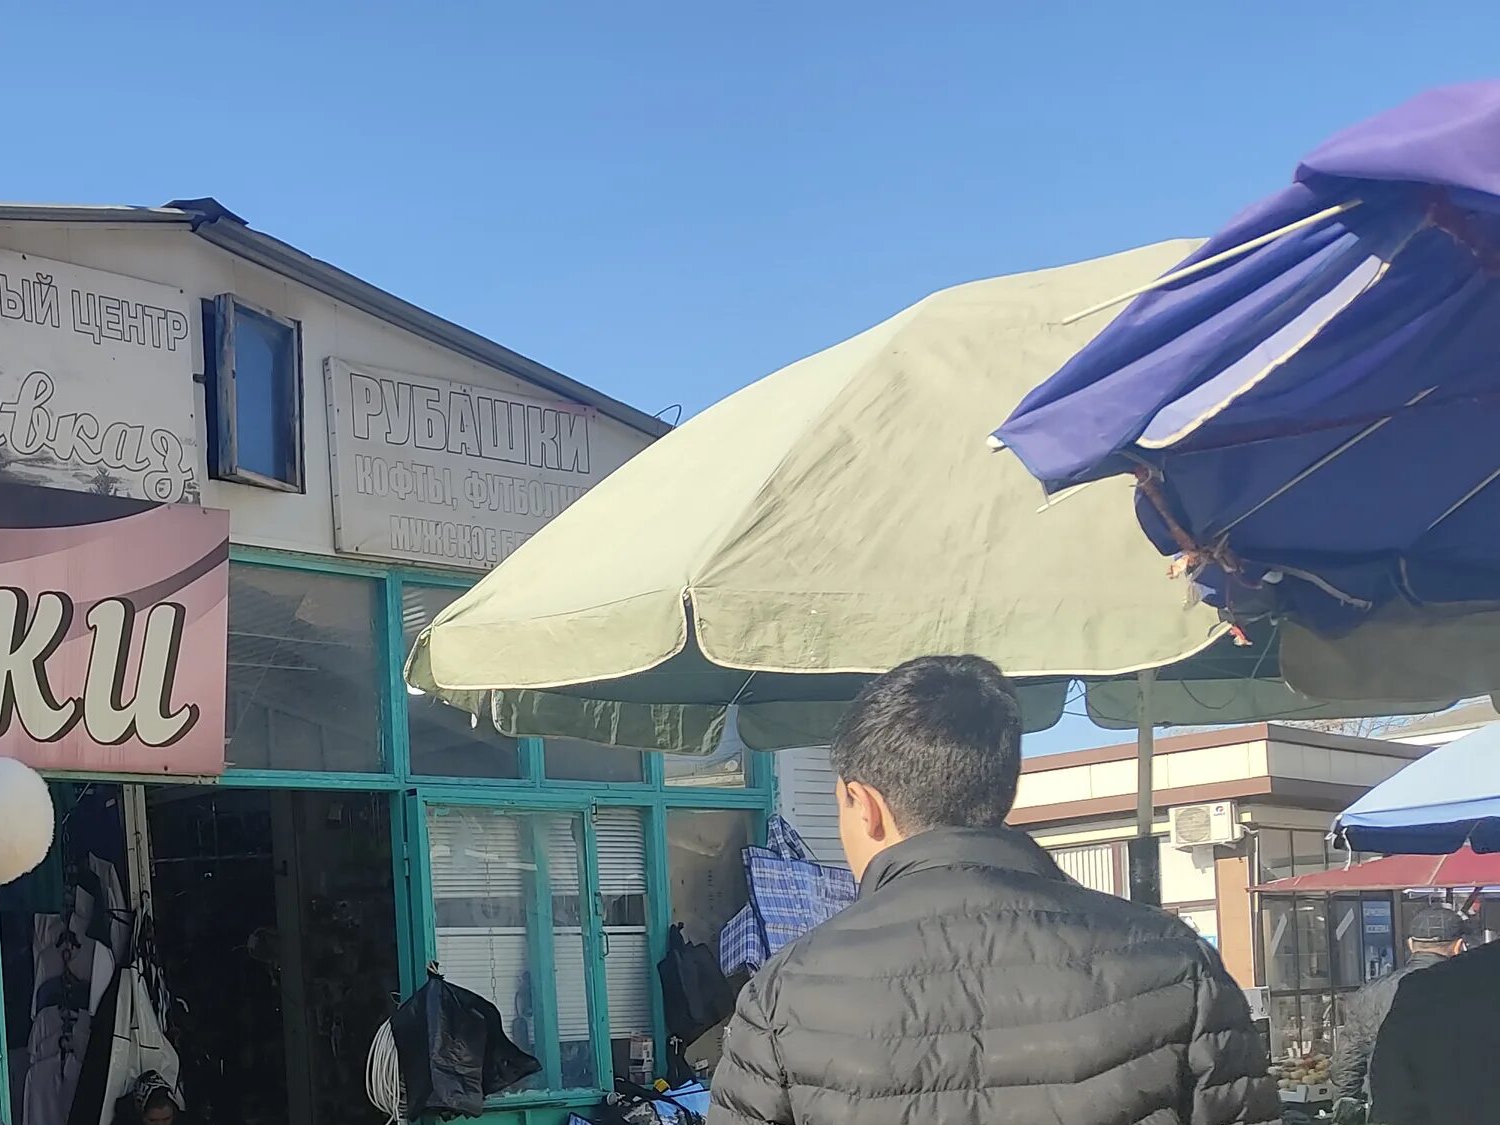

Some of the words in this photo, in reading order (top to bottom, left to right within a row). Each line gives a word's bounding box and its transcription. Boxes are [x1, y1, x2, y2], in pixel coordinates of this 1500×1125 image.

[71, 290, 189, 351] ЦЕНТР
[350, 373, 590, 474] РУБАШКИ
[355, 454, 458, 511] КОФТЫ,
[389, 515, 498, 562] МУЖСКОЕ
